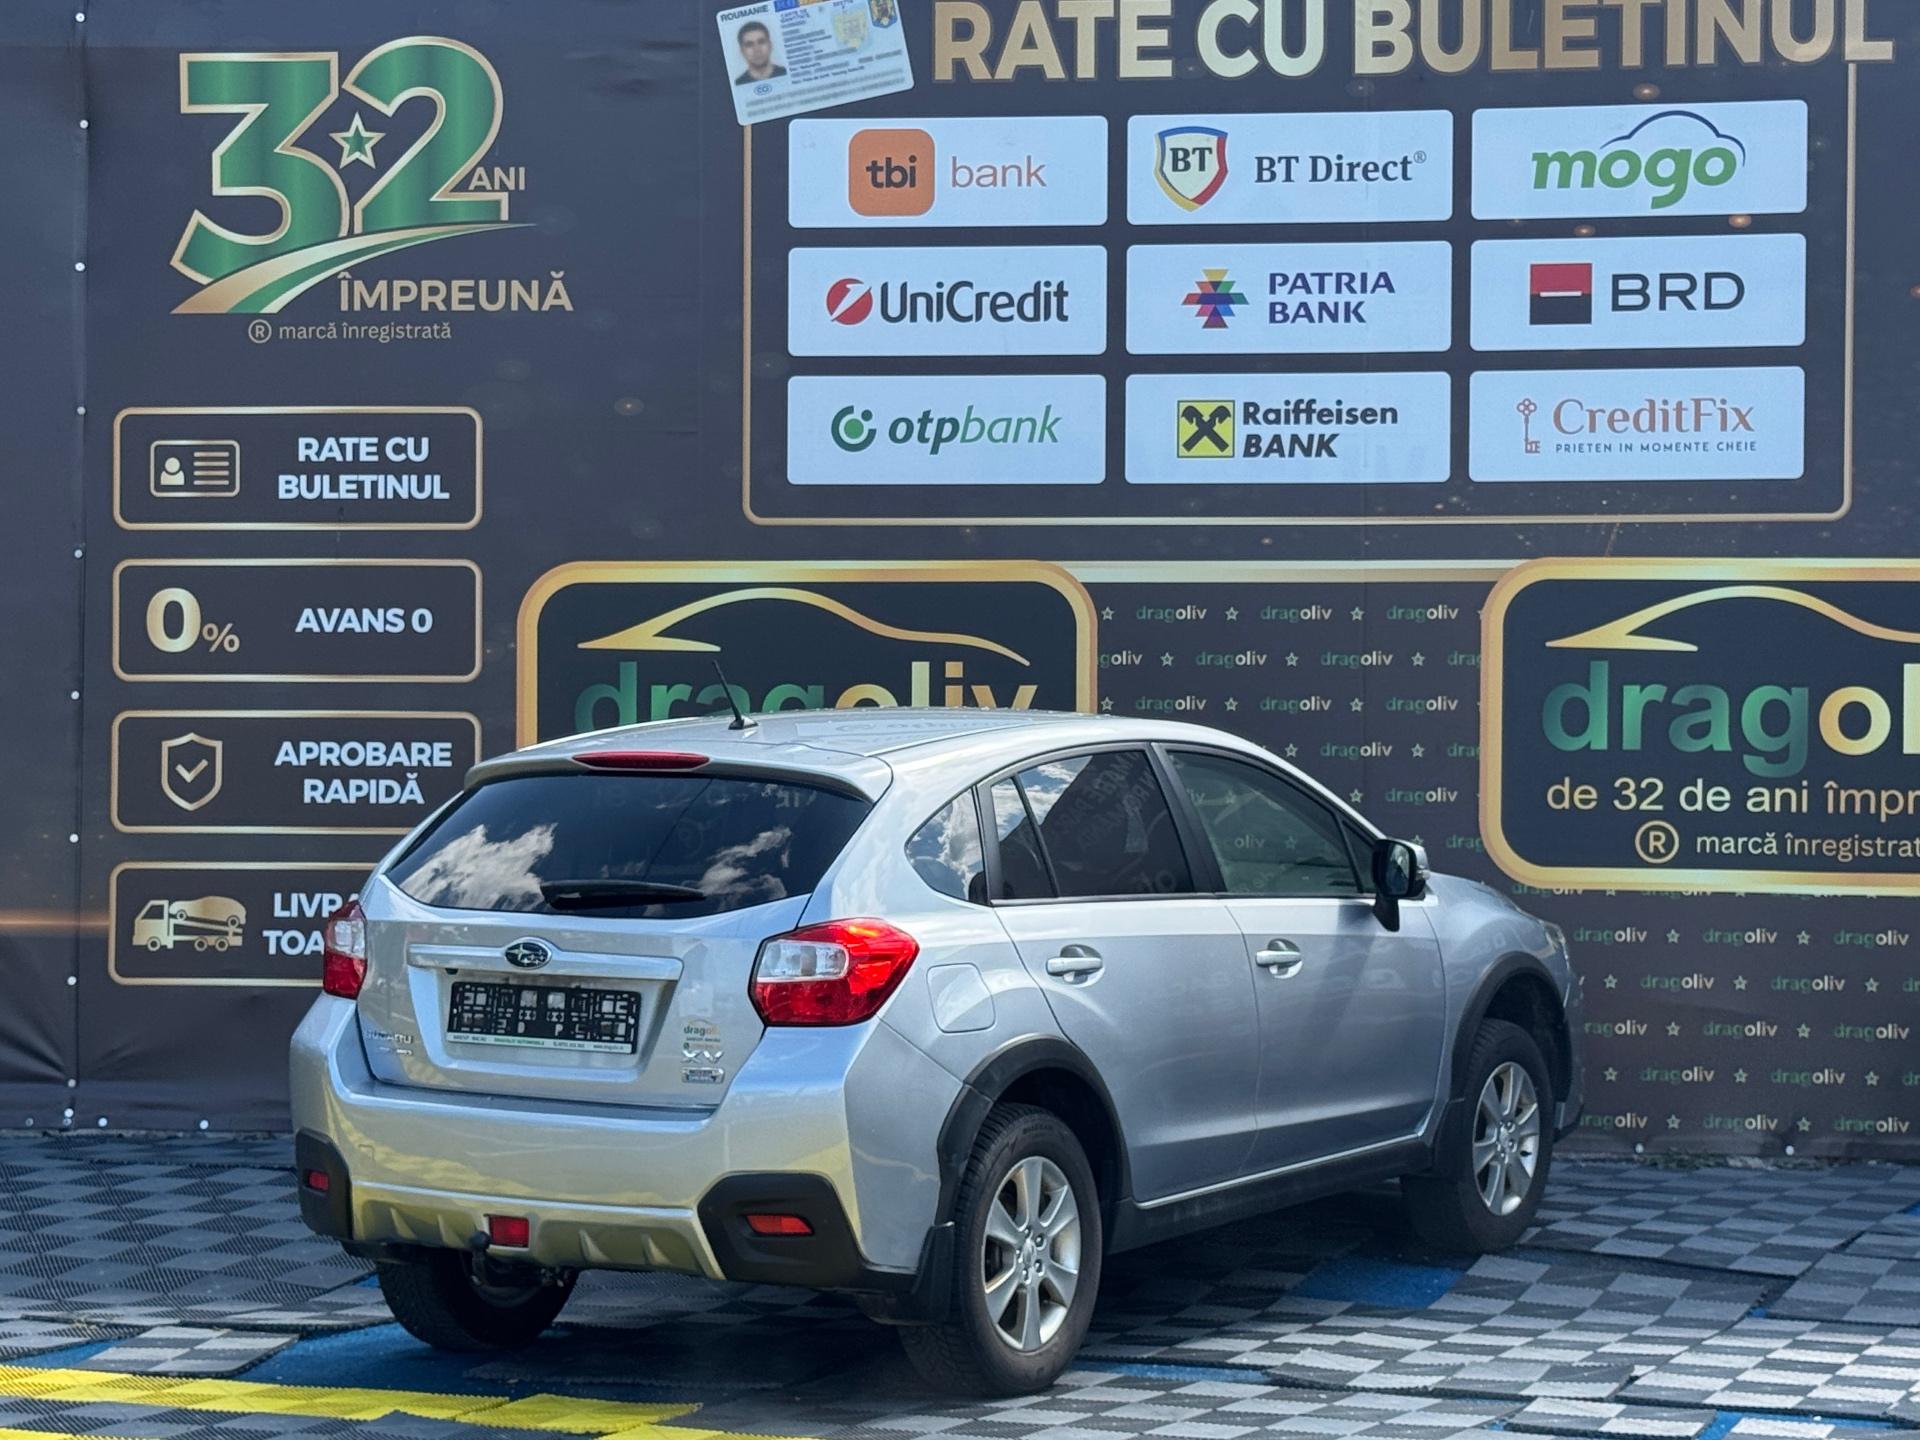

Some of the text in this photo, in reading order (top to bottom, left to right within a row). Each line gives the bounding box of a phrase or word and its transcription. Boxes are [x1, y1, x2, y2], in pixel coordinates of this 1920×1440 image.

[933, 0, 1173, 81] RATE
[1197, 0, 1324, 79] CU
[1353, 0, 1894, 75] BULETINUL
[170, 36, 509, 285] 32
[1169, 147, 1212, 172] BT
[1254, 156, 1299, 183] BT
[469, 166, 526, 190] ANI
[866, 156, 917, 189] tbi
[951, 156, 1047, 189] bank
[1532, 146, 1737, 209] mogo
[339, 271, 573, 312] ÎMPREUNĂ
[1268, 271, 1395, 295] PATRIA
[1611, 271, 1745, 312] BRD
[880, 279, 1069, 324] UniCredit
[1268, 301, 1366, 324] BANK
[279, 322, 338, 340] marcă
[342, 320, 452, 343] înregistrată
[1242, 399, 1398, 425] Raiffeisen
[1552, 397, 1755, 434] CreditFix
[888, 404, 1062, 455] otpbank
[297, 437, 430, 462] RATE CU
[1242, 433, 1340, 459] BANK
[1556, 441, 1757, 454] PRIETEN IN MOMENTE CHEIE
[278, 473, 450, 499] BULETINUL
[294, 607, 433, 634] AVANS 0
[1136, 604, 1207, 623] dragoliv
[1260, 604, 1332, 623] dragoliv
[1386, 604, 1459, 623] dragoliv
[1196, 650, 1267, 669] dragoliv
[1320, 650, 1393, 669] dragoliv
[1135, 696, 1206, 714] dragoliv
[1260, 696, 1332, 714] dragoliv
[1386, 695, 1458, 714] dragoliv
[1542, 660, 1920, 777] dragol
[274, 741, 453, 768] APROBARE
[1320, 741, 1392, 761] dragoliv
[303, 772, 425, 804] RAPIDĂ
[1385, 787, 1458, 806] dragoliv
[1547, 776, 1920, 822] de 32 de ani împr
[1696, 832, 1778, 857] marcă
[1785, 833, 1920, 862] înregistrat
[274, 893, 359, 918] LIVR
[262, 930, 325, 956] TOA
[1574, 927, 1647, 946] dragoliv
[1703, 927, 1777, 946] dragoliv
[1834, 929, 1909, 948] dragoliv
[1640, 974, 1714, 992] dragoliv
[1771, 975, 1845, 993] dragoliv
[1584, 1020, 1647, 1038] ragoliv
[1703, 1021, 1778, 1040] dragoliv
[1834, 1023, 1909, 1041] dragoliv
[1640, 1067, 1715, 1085] dragoliv
[1771, 1069, 1845, 1088] dragoliv
[1702, 1114, 1778, 1134] dragoliv
[1834, 1116, 1909, 1136] dragoliv
